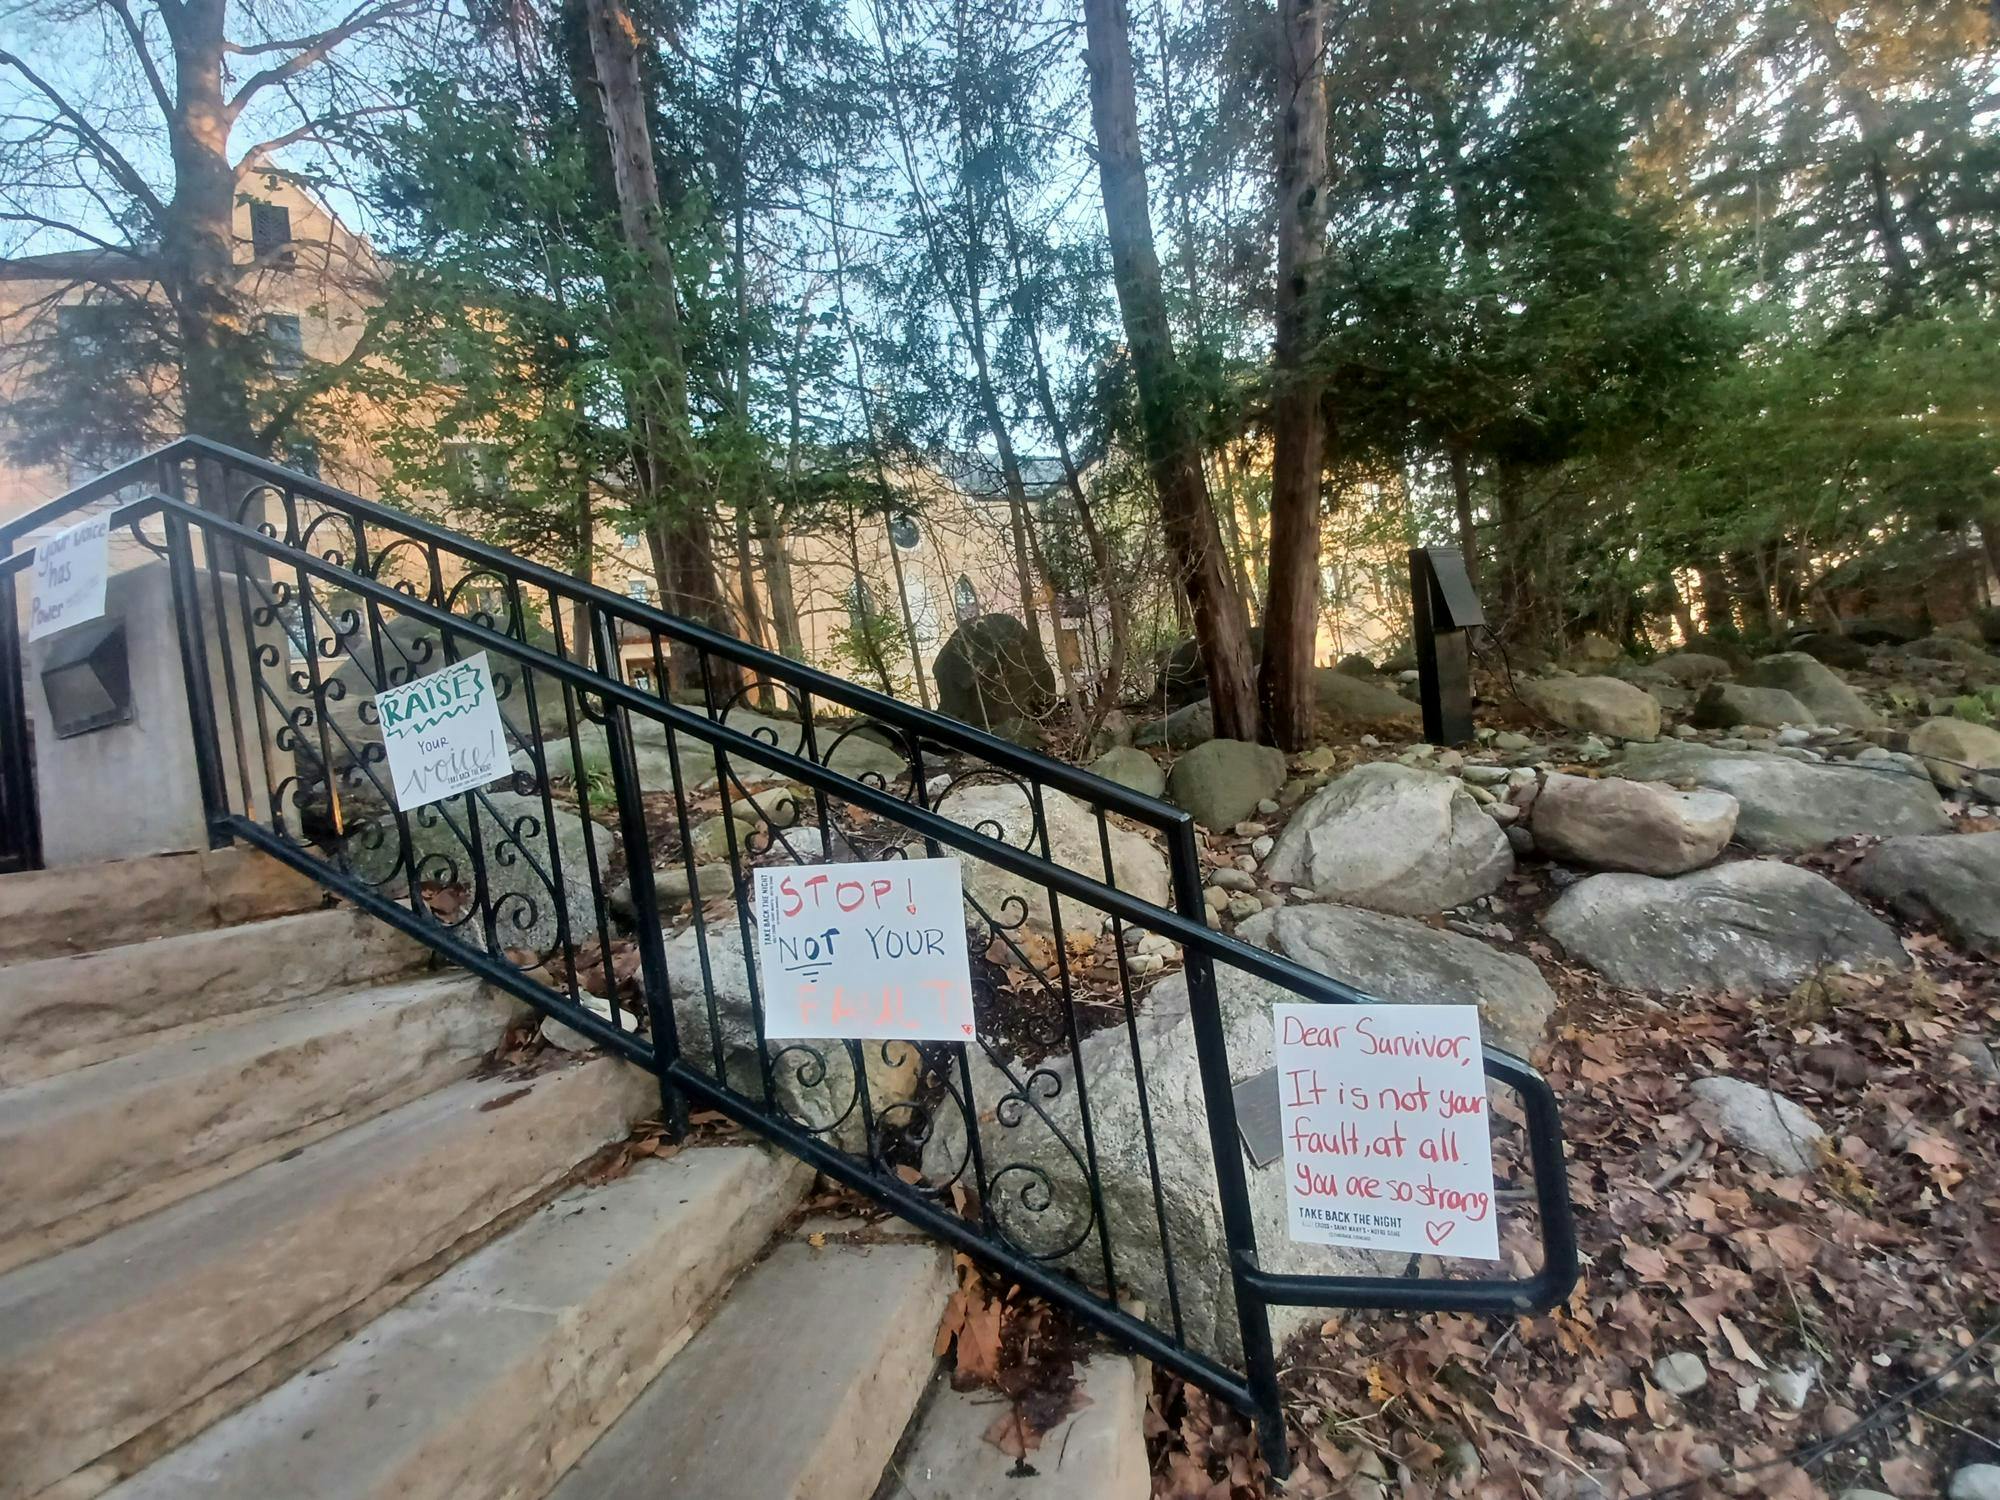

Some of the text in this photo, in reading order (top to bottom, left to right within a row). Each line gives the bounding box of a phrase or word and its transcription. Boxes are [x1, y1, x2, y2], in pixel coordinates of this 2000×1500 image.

[385, 671, 471, 726] RAISE
[418, 737, 449, 755] YOUR
[780, 874, 917, 917] STOP!
[779, 925, 945, 963] NOT YOUR
[1283, 1016, 1471, 1067] Dear Survivor,
[1286, 1070, 1327, 1107] It
[1339, 1083, 1369, 1110] is
[1379, 1077, 1430, 1112] not
[1299, 1207, 1402, 1228] TAKE BACK THE NIGHT
[1346, 1175, 1382, 1199] are
[1387, 1179, 1413, 1202] so
[1415, 1173, 1489, 1221] strong
